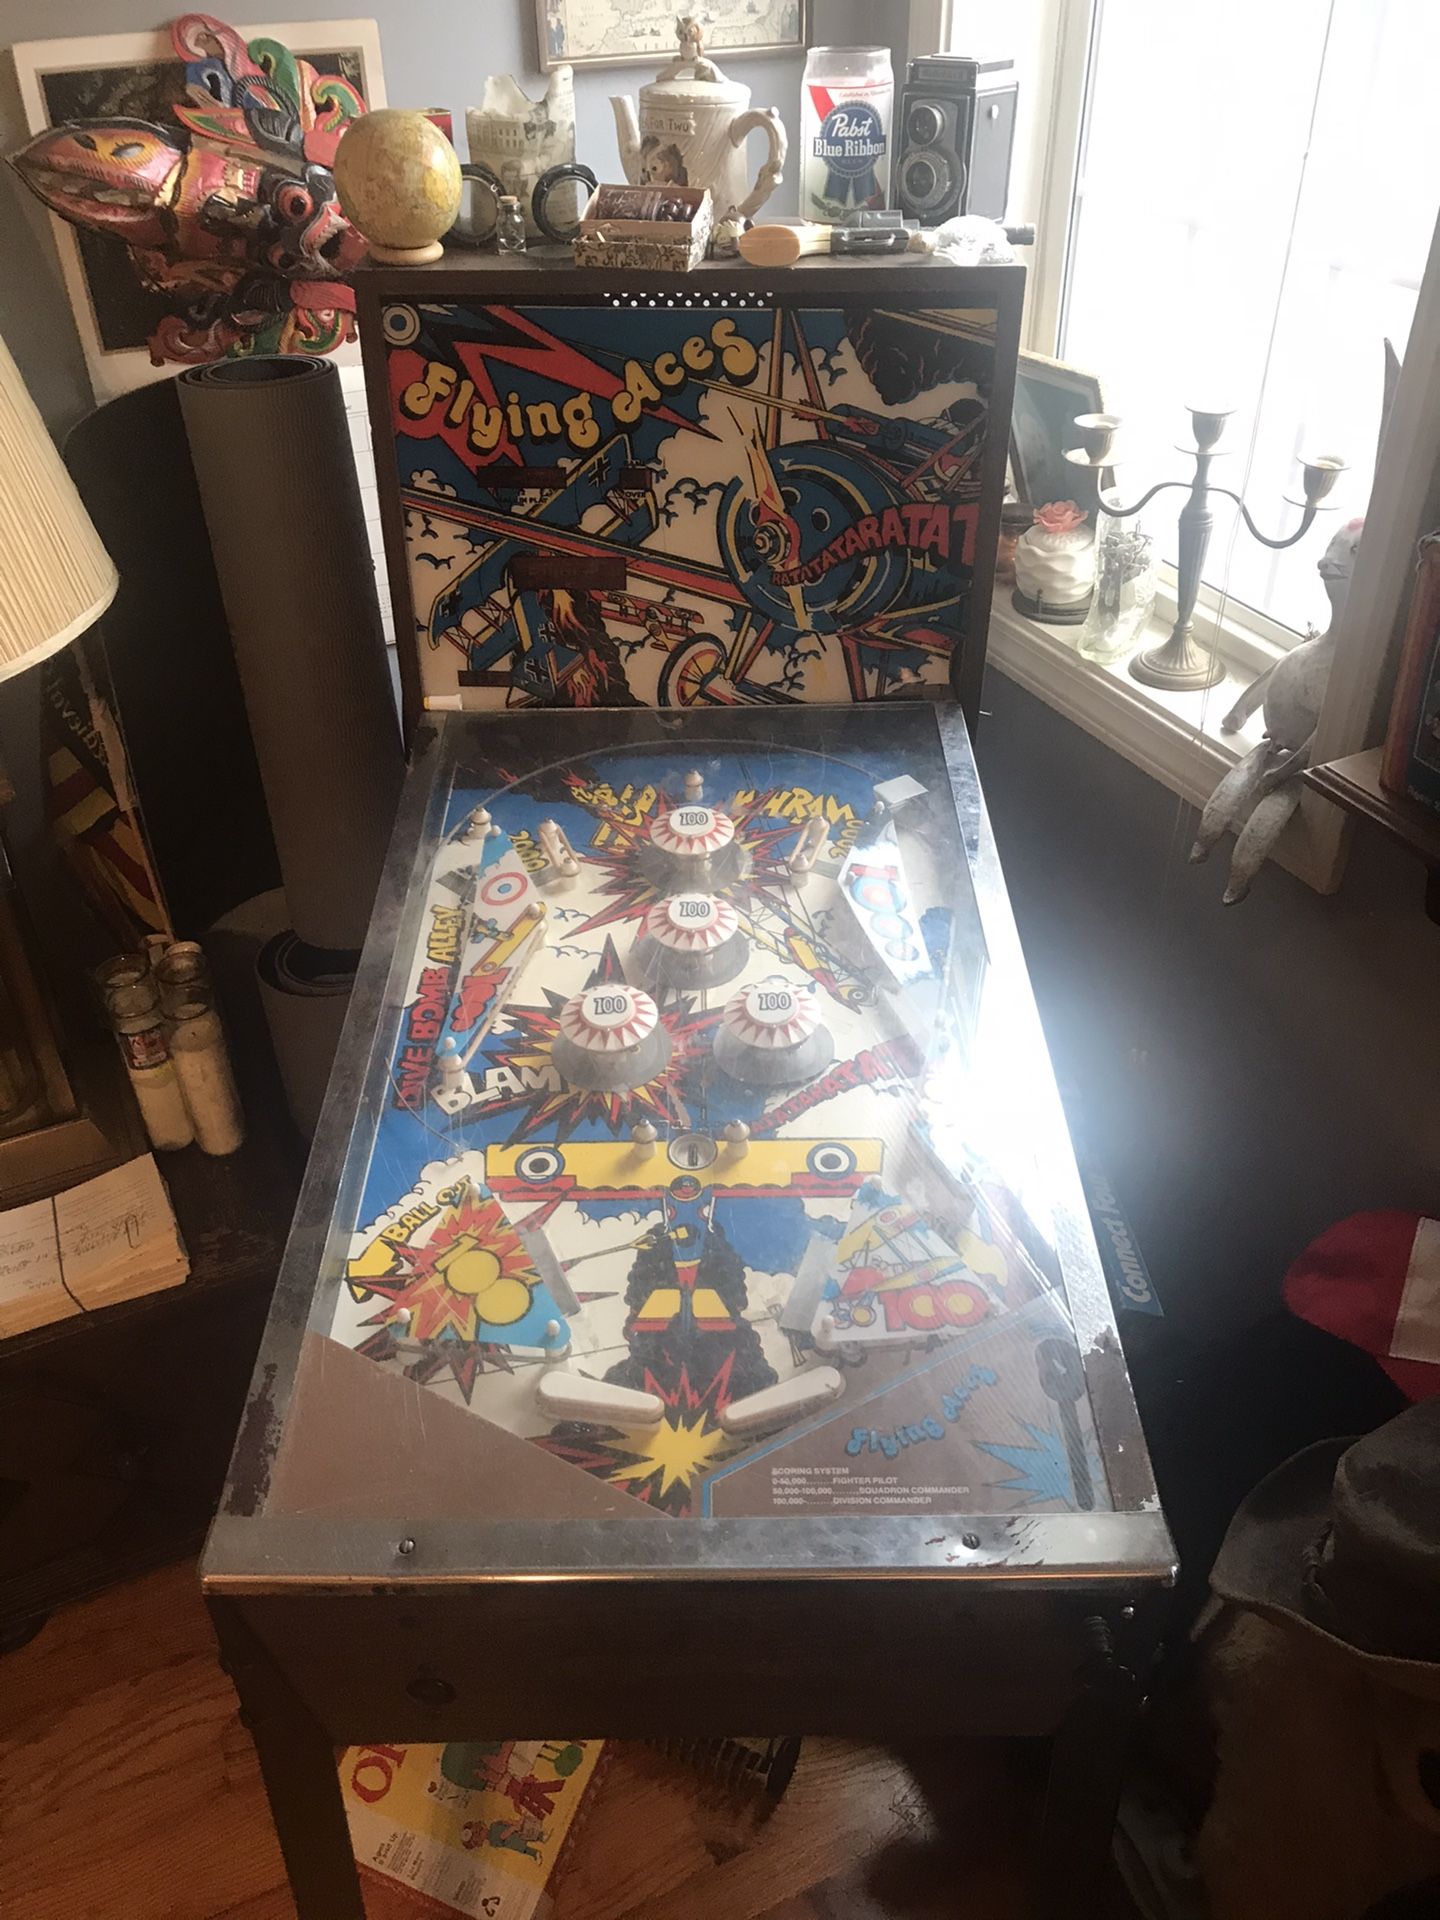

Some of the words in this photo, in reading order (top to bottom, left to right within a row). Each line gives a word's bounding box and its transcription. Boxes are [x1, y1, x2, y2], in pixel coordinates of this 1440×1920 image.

[831, 113, 873, 137] Pabst
[814, 139, 842, 157] Blue
[844, 139, 885, 156] Ribbon
[401, 360, 601, 454] Flying
[610, 317, 759, 428] Aces
[679, 811, 709, 826] 100
[679, 901, 711, 918] 100
[426, 904, 466, 967] ALLEY
[407, 965, 451, 1042] BOMB
[593, 995, 628, 1015] 100
[758, 991, 792, 1011] 100
[394, 1044, 434, 1111] DIVE
[380, 1201, 443, 1244] BALL
[845, 1414, 946, 1461] Flying
[771, 1467, 812, 1475] SCORING
[813, 1467, 849, 1475] SYSTEM
[872, 1476, 899, 1485] PILOT
[910, 1486, 970, 1495] COMMANDER
[832, 1496, 872, 1506] DIVISION
[872, 1497, 932, 1506] COMMANDER
